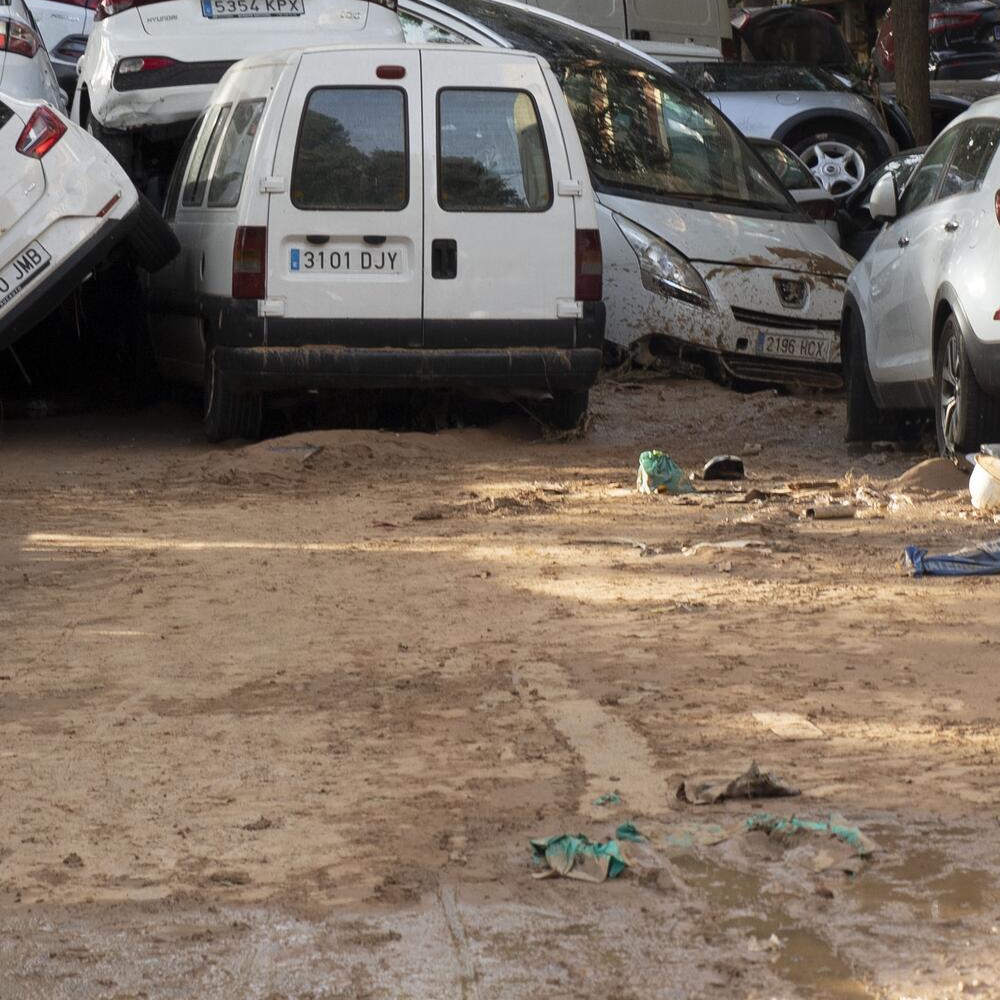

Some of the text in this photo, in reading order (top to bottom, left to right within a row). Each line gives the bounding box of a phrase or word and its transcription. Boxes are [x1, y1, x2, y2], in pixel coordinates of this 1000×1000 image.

[215, 0, 299, 13] 5354 KPX
[13, 248, 42, 280] JMB
[304, 251, 398, 270] 3101 DJY
[766, 336, 824, 357] 2196 HCX
